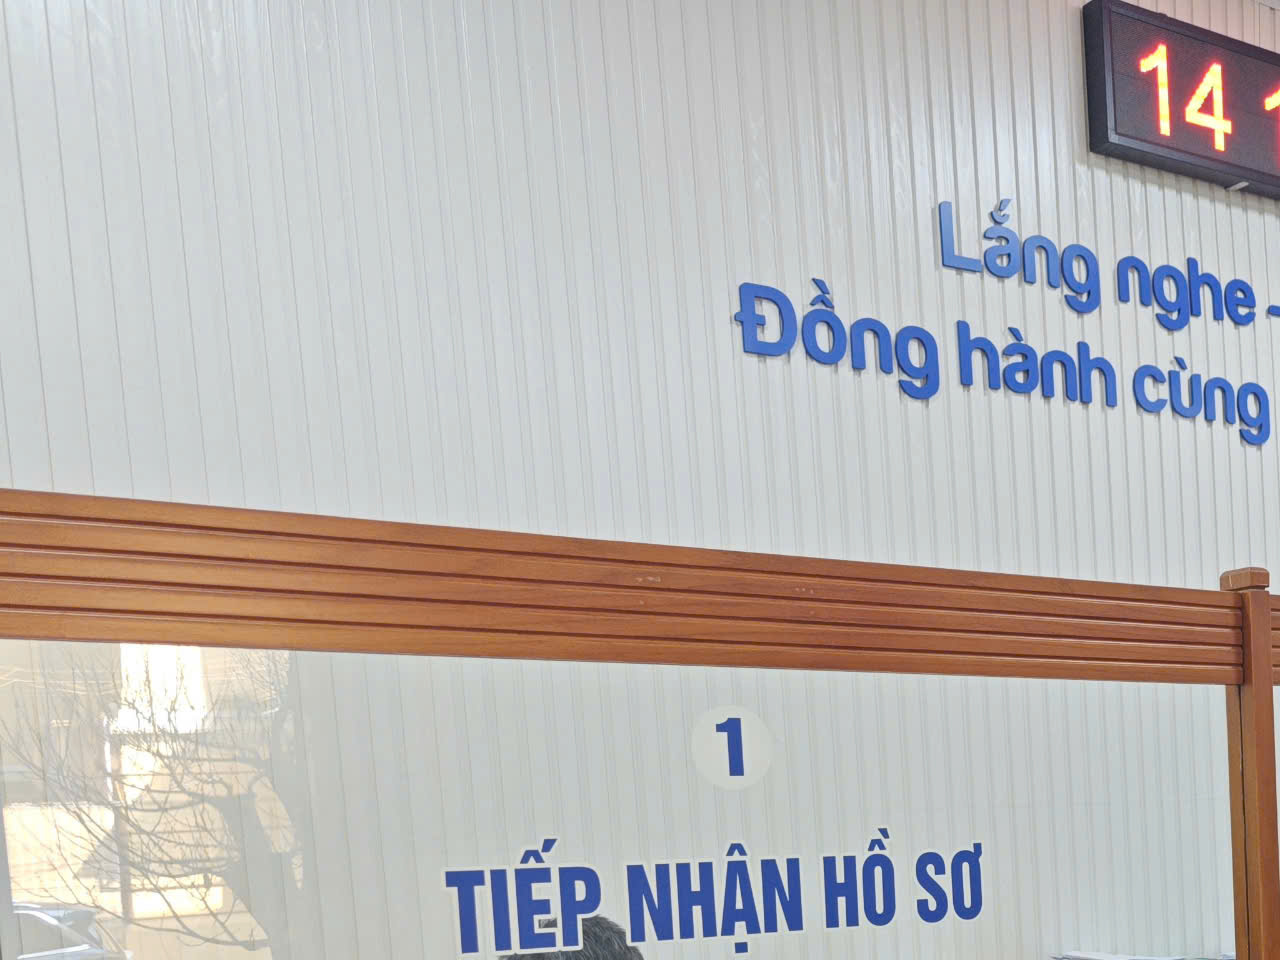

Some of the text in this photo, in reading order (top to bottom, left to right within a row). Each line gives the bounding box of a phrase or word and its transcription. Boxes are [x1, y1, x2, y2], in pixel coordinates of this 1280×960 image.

[1139, 43, 1233, 152] 14
[939, 198, 1101, 314] Lắng
[1116, 255, 1256, 331] nghe
[734, 277, 940, 400] Đồng
[956, 319, 1118, 408] hành
[1132, 356, 1271, 446] cùng
[715, 717, 745, 777] 1
[445, 827, 983, 954] TIẾP NHẬN HỒ SƠ
